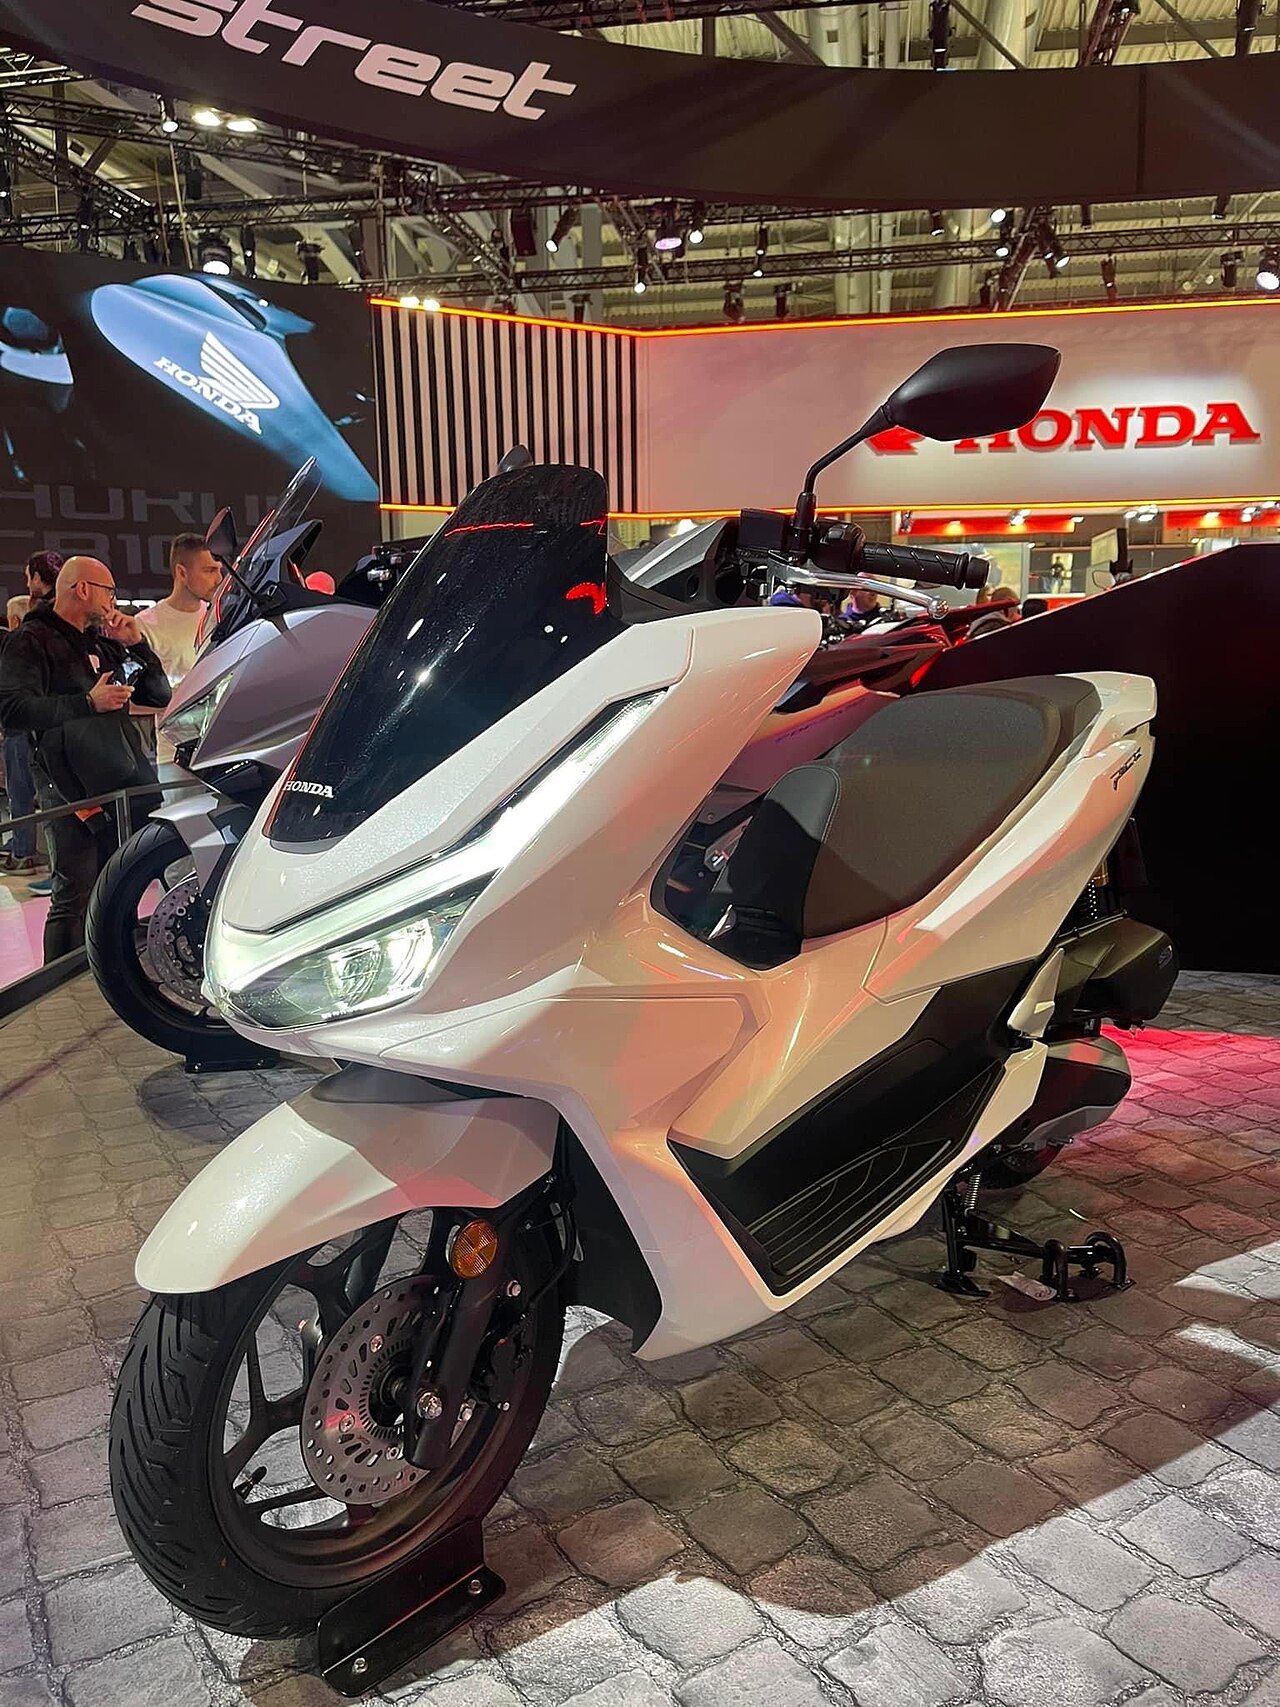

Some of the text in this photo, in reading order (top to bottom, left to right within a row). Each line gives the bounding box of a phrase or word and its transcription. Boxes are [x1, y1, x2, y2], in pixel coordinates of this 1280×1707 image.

[131, 0, 577, 121] street
[153, 355, 263, 435] HONDA
[282, 780, 335, 799] HONDA
